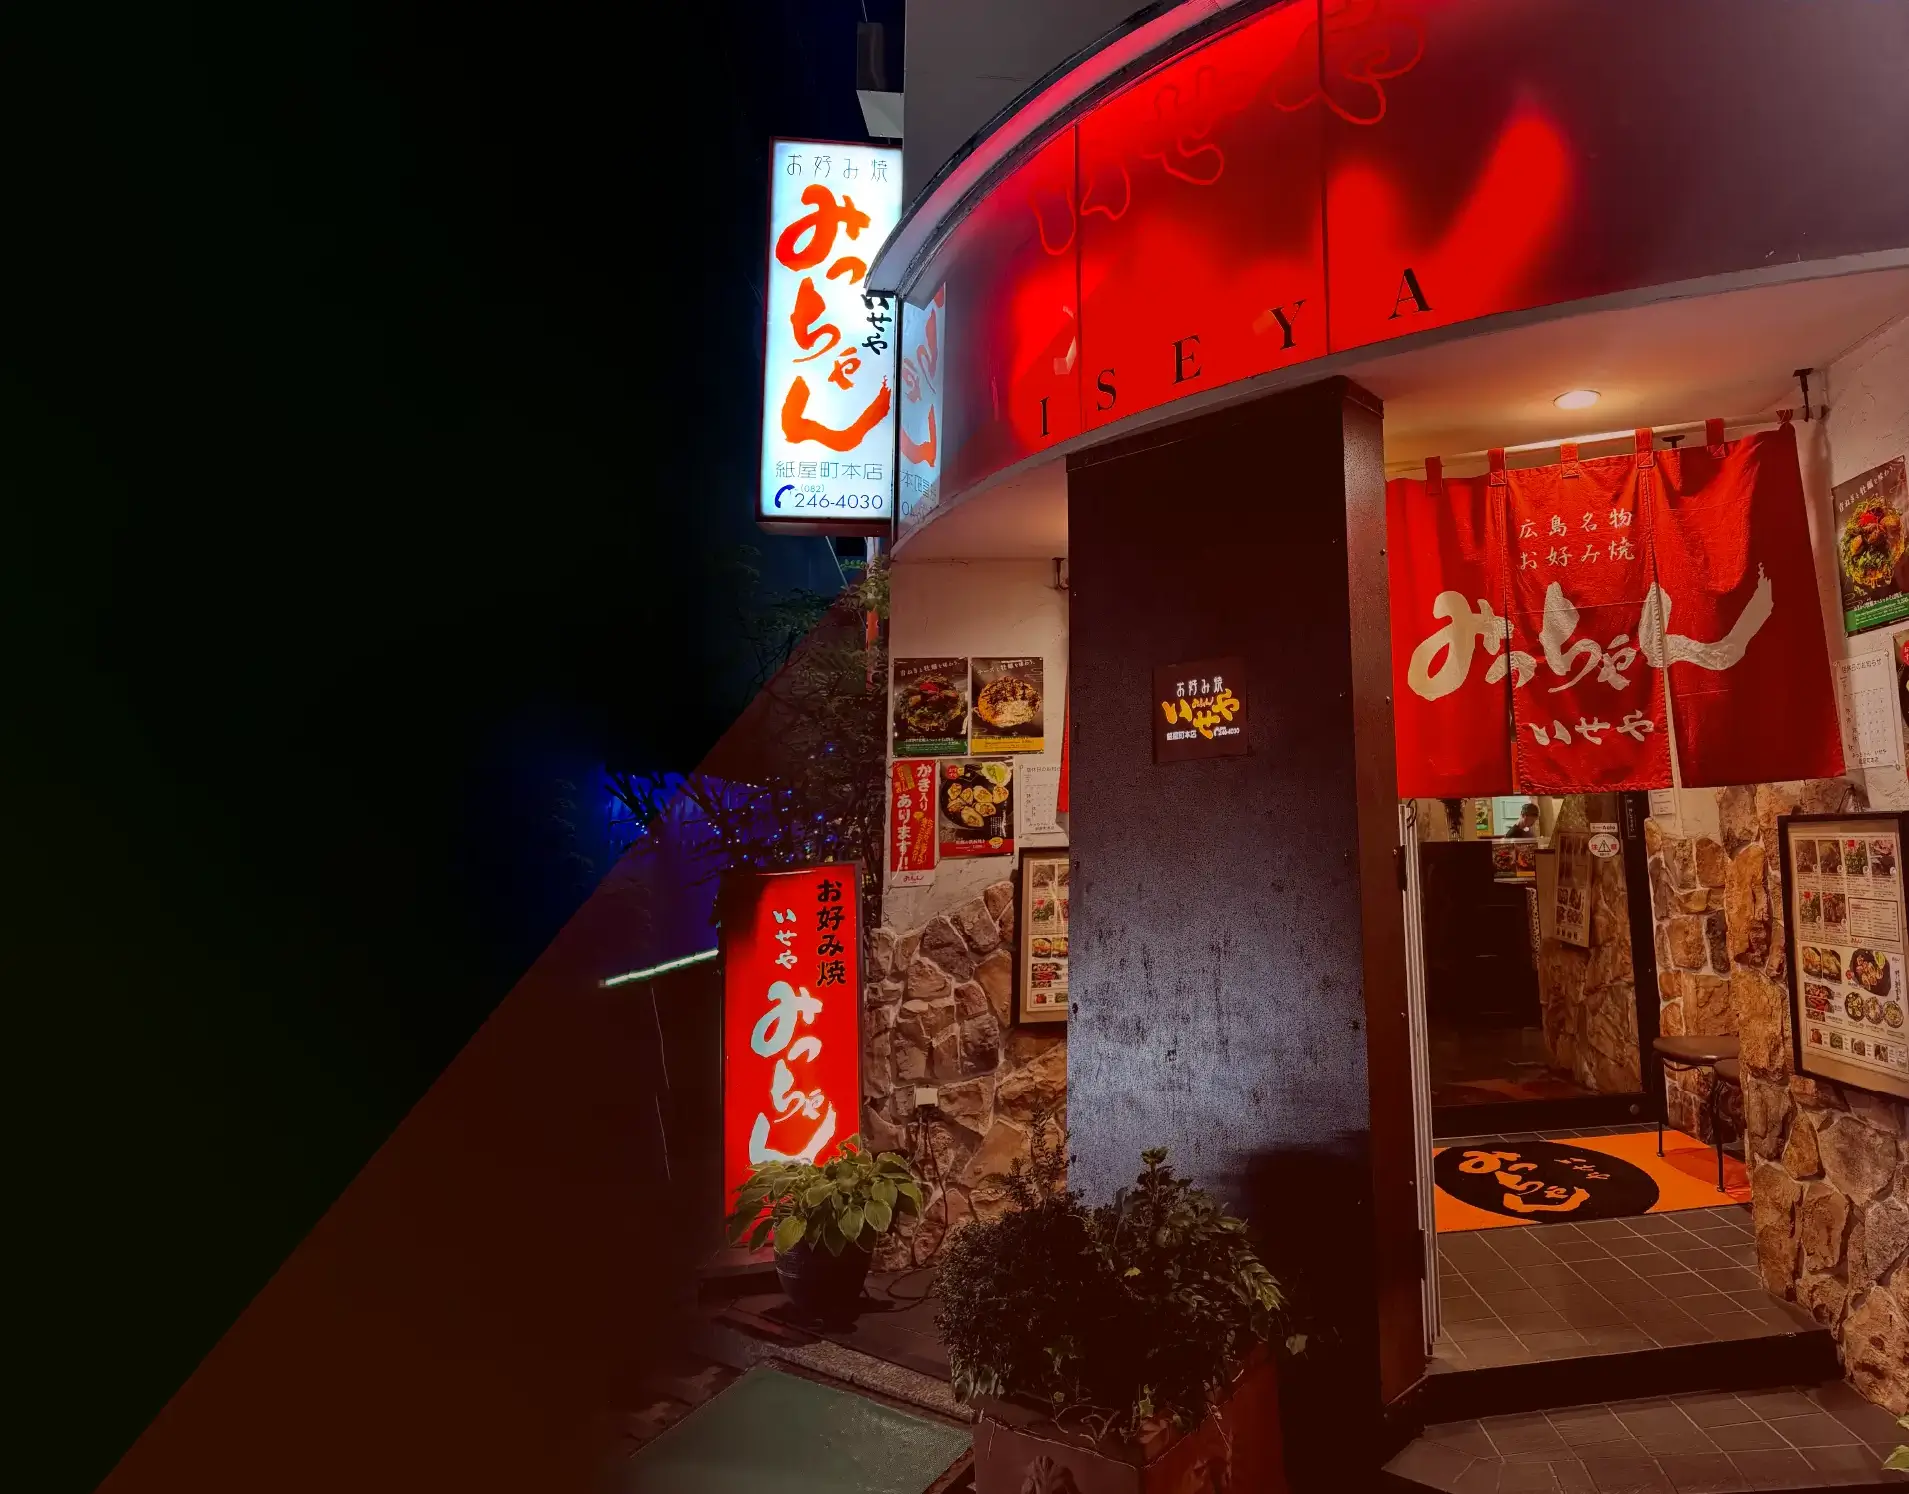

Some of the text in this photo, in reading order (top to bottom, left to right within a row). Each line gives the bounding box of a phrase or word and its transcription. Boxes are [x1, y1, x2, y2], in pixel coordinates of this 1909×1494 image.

[785, 154, 889, 183] お好み焼
[775, 184, 891, 452] みっちゃん
[861, 293, 892, 355] いせや
[1039, 268, 1432, 438] ISEYA
[776, 460, 883, 480] 紙屋町本店
[794, 492, 884, 510] 246-4030
[1518, 508, 1633, 540] 広島名物
[1519, 537, 1636, 571] お好み焼
[1408, 562, 1775, 701] みっちゃん
[1176, 676, 1224, 697] お好み焼
[1529, 710, 1654, 746] いせや
[916, 763, 933, 811] かき入り
[773, 908, 798, 970] いせや
[816, 878, 847, 986] お好み焼
[749, 980, 837, 1166] みっちゃん
